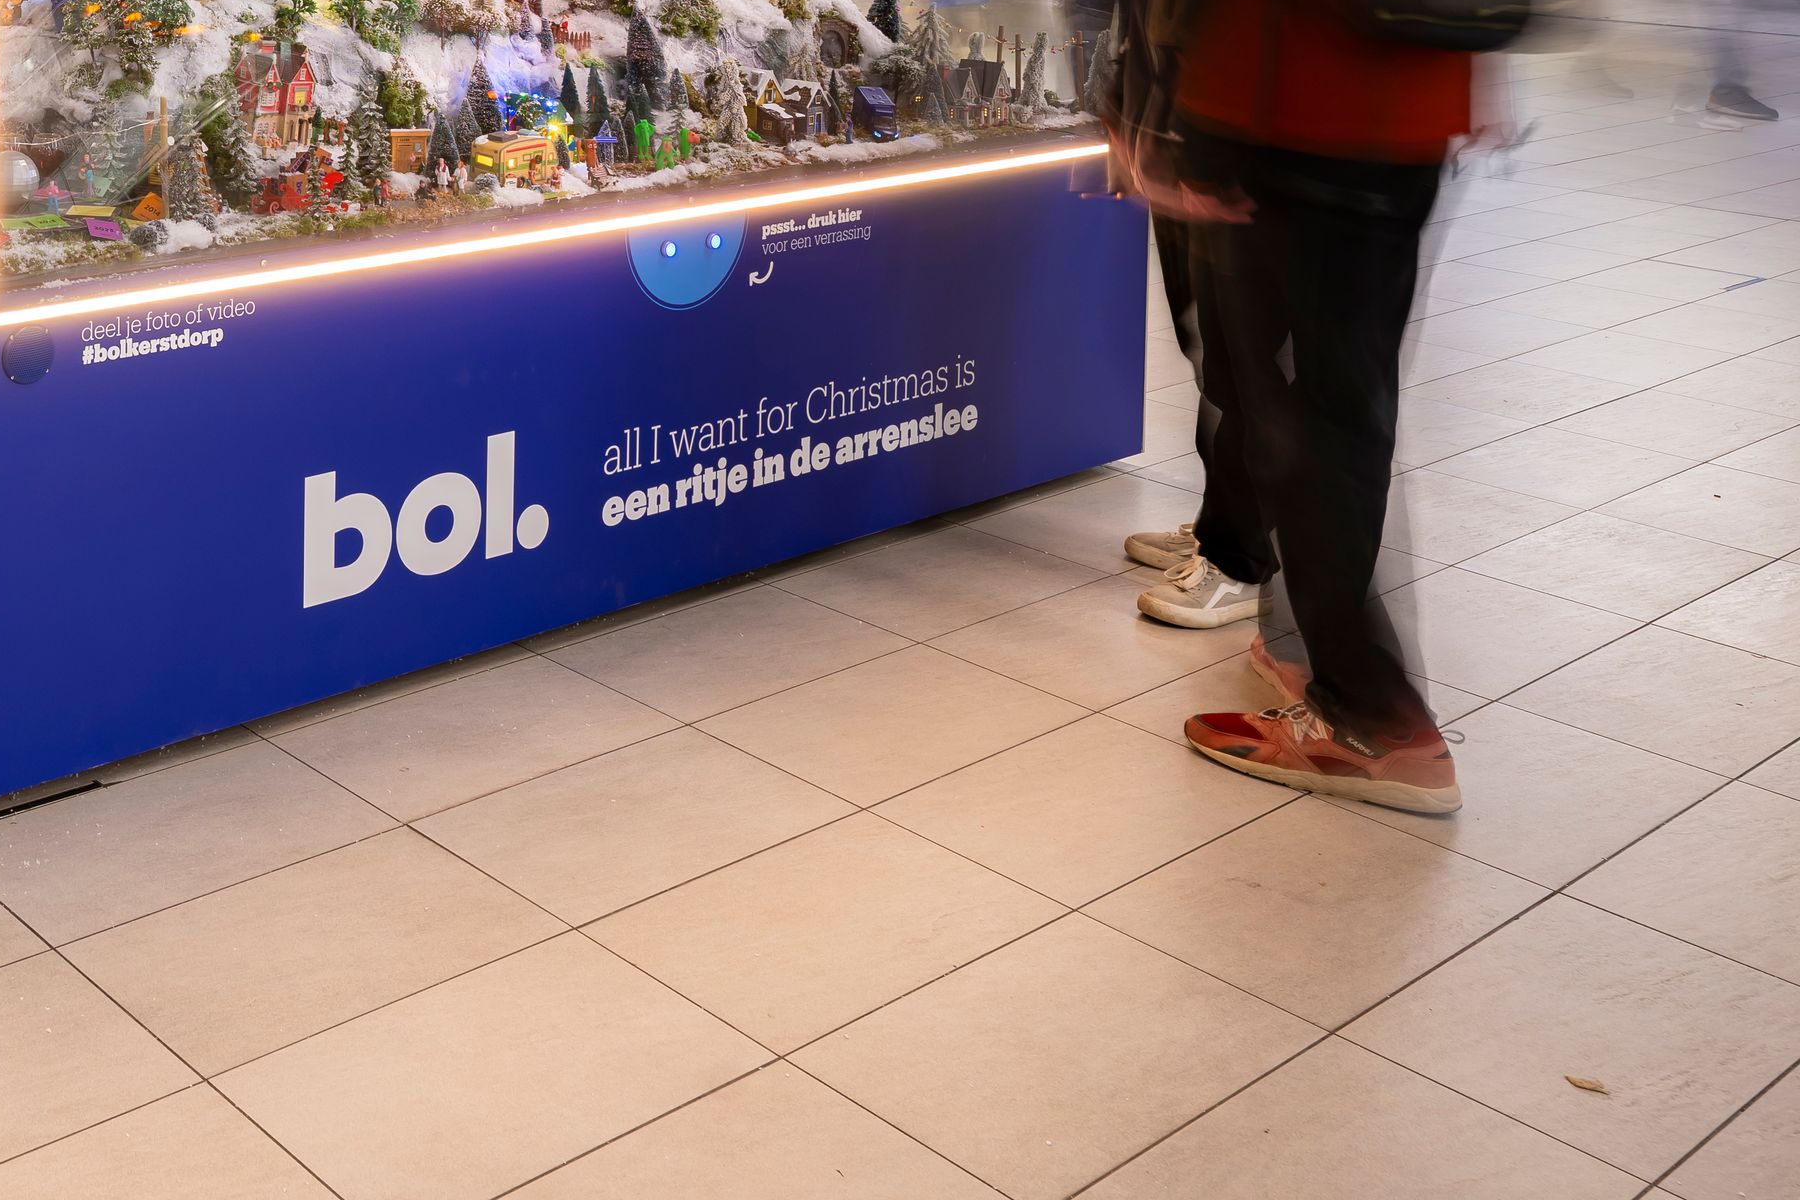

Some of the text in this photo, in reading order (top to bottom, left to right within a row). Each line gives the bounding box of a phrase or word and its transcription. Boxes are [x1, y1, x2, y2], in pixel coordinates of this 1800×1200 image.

[761, 207, 863, 240] pssst... druk hier
[761, 224, 872, 256] voor een verrassing
[81, 298, 256, 342] deel je foto of video
[82, 327, 224, 366] #bolkerstdorp
[603, 353, 976, 476] all I want for Christmas is
[602, 401, 979, 528] een ritje in de arrenslee
[303, 430, 550, 609] bol.
